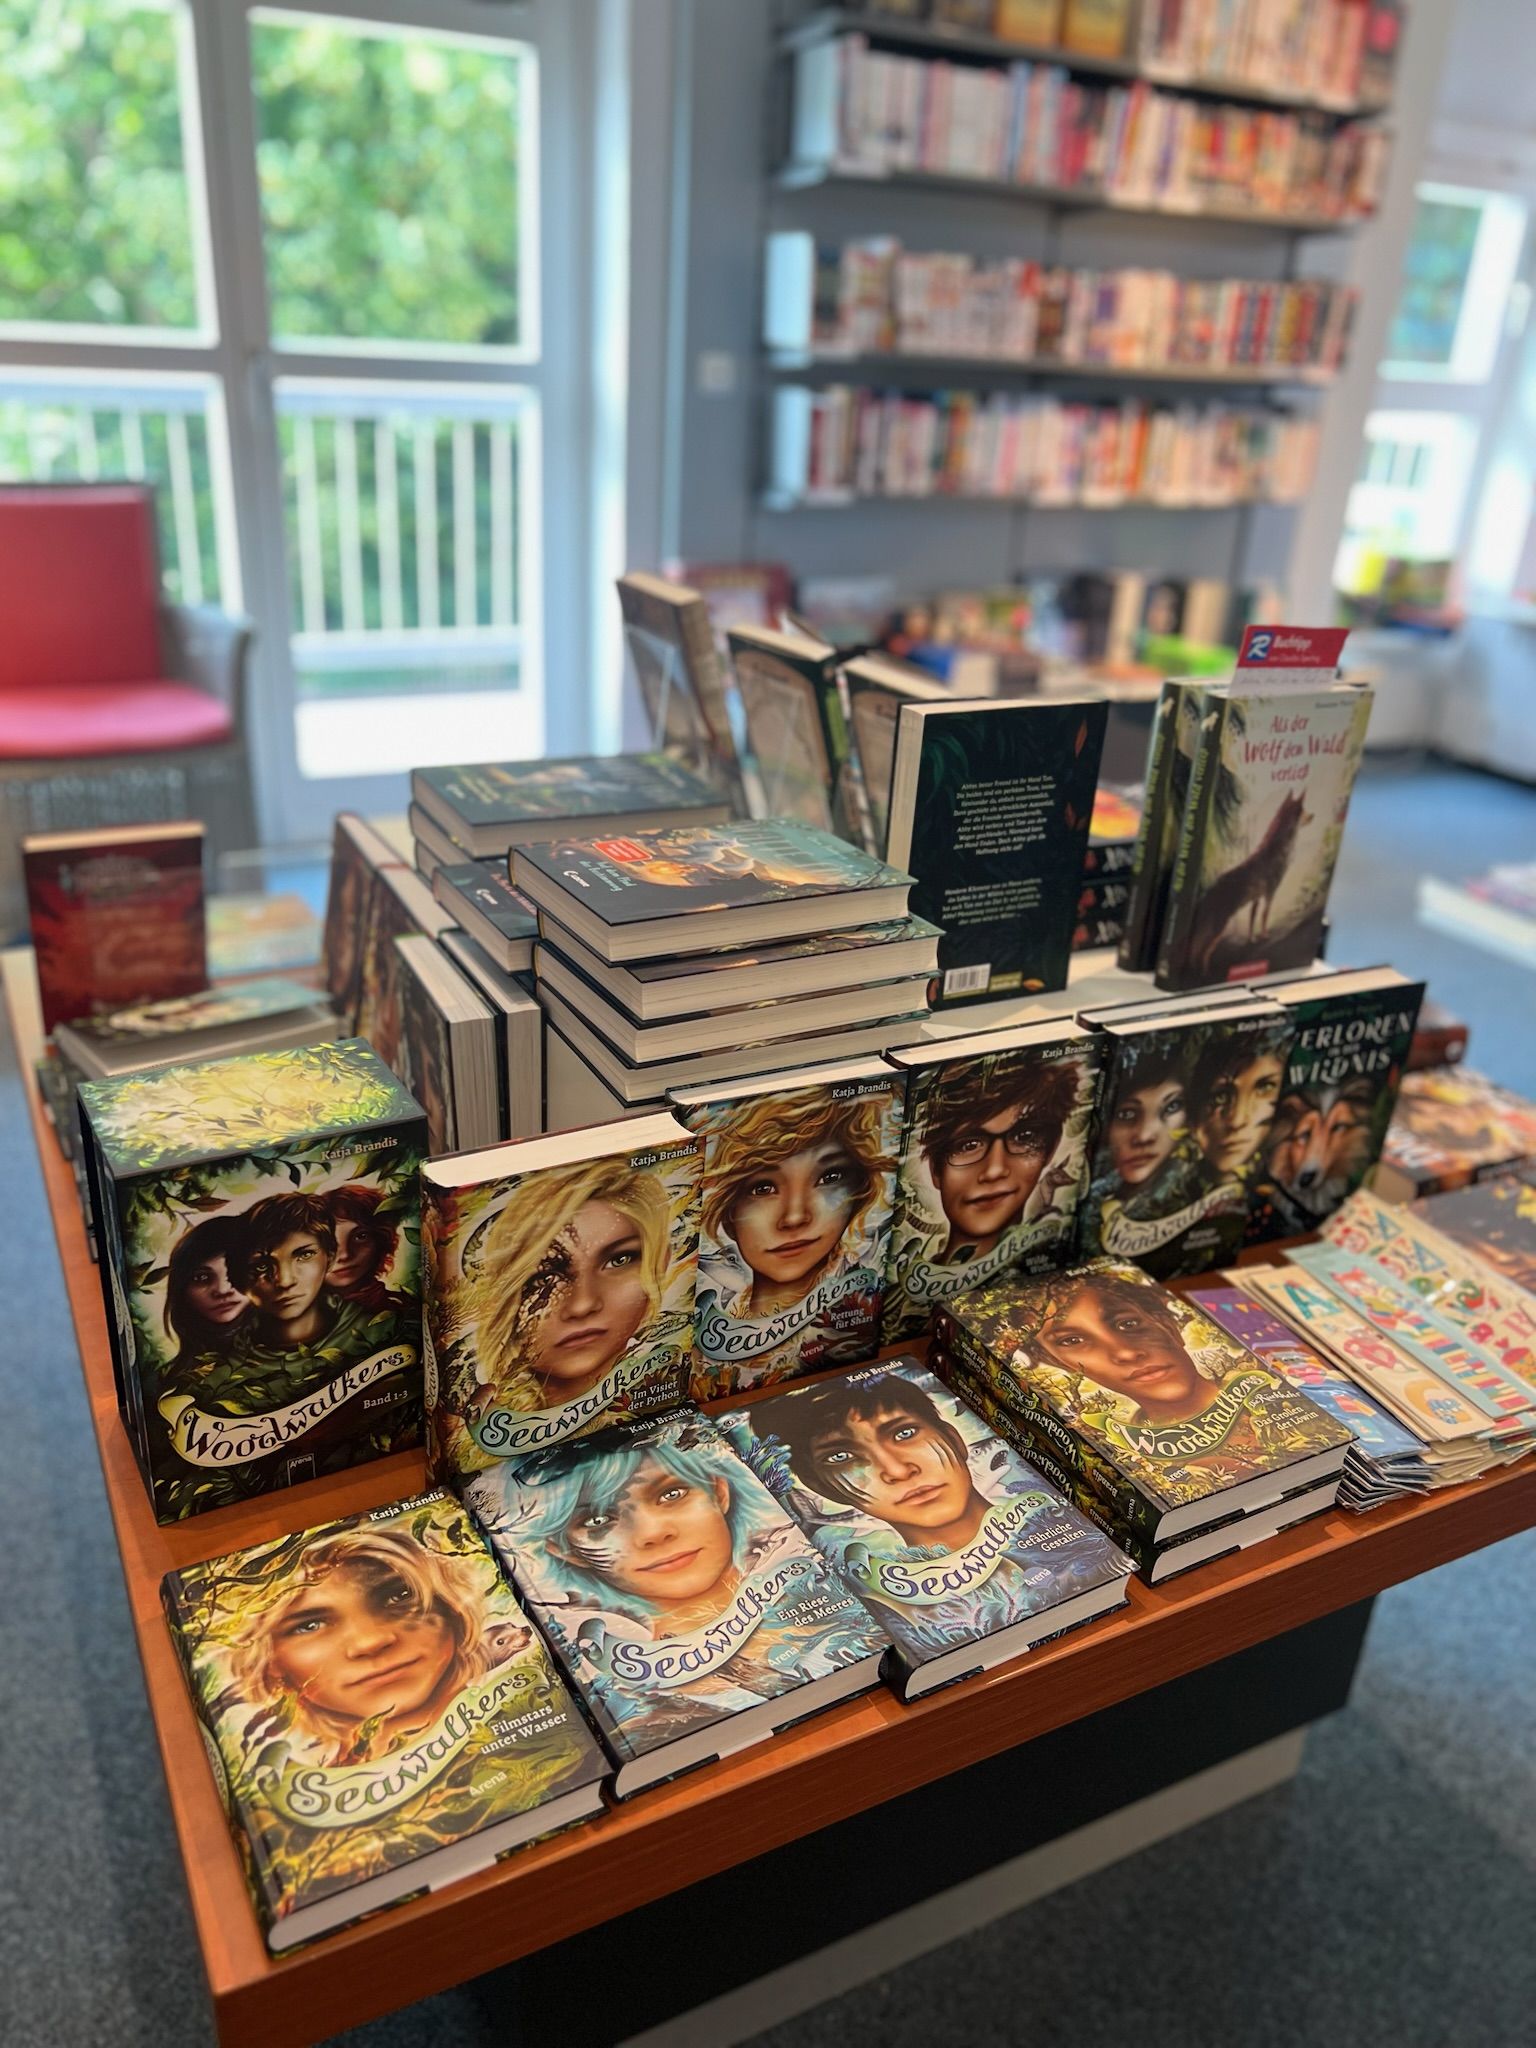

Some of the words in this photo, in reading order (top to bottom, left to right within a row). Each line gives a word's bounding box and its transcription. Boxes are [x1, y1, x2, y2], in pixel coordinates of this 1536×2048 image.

[1308, 732, 1347, 755] Wald
[1296, 1011, 1413, 1048] ERLOREN
[1042, 1047, 1063, 1059] Katja
[1064, 1042, 1095, 1057] Brandis
[832, 1086, 854, 1099] Katja
[856, 1081, 891, 1095] Brandis
[321, 1144, 351, 1161] Katja
[354, 1136, 398, 1156] Brandis
[630, 1151, 656, 1168] Katja
[659, 1144, 698, 1163] Brandis
[906, 1224, 1056, 1296] Seawalkers
[1066, 1265, 1087, 1277] Katja
[1087, 1258, 1118, 1272] Brandis
[702, 1271, 870, 1354] Seawalkers
[830, 1307, 864, 1323] Rettung
[835, 1317, 849, 1330] für
[851, 1314, 873, 1327] Shari
[800, 1344, 825, 1357] Arena
[846, 1369, 869, 1383] Katja
[871, 1360, 903, 1376] Brandis
[363, 1393, 390, 1410] Band
[393, 1390, 408, 1404] 1-3
[480, 1348, 683, 1449] Seawalkers
[627, 1399, 645, 1411] der
[647, 1387, 680, 1408] Python
[633, 1388, 646, 1400] Im
[648, 1379, 678, 1396] Visier
[183, 1349, 412, 1462] Woodwalkers
[1114, 1375, 1266, 1458] Woodwalkers
[1254, 1415, 1273, 1428] Das
[1271, 1405, 1304, 1422] Grollen
[628, 1420, 655, 1434] Katja
[656, 1406, 694, 1426] Brandis
[1277, 1420, 1291, 1431] der
[1290, 1411, 1319, 1427] Löwin
[289, 1455, 313, 1468] Arena
[1092, 1468, 1118, 1498] Brandis
[369, 1506, 400, 1523] Katja
[401, 1490, 445, 1512] Brandis
[1126, 1499, 1136, 1520] Arena
[1089, 1508, 1114, 1536] Brandis
[880, 1494, 1047, 1598] Seawalkers
[1016, 1521, 1073, 1551] Gefährliche
[1041, 1528, 1087, 1554] Gestalten
[1025, 1568, 1052, 1586] Arena
[612, 1560, 813, 1681] Seawalkers
[776, 1606, 795, 1621] Ein
[797, 1594, 828, 1612] Riese
[793, 1614, 812, 1629] des
[813, 1597, 854, 1622] Meeres
[768, 1647, 798, 1667] Arena
[481, 1731, 517, 1755] unter
[519, 1712, 568, 1741] Wasser
[491, 1704, 553, 1737] Filmstars
[287, 1672, 539, 1817] Seawalkers
[469, 1769, 507, 1798] Arena
